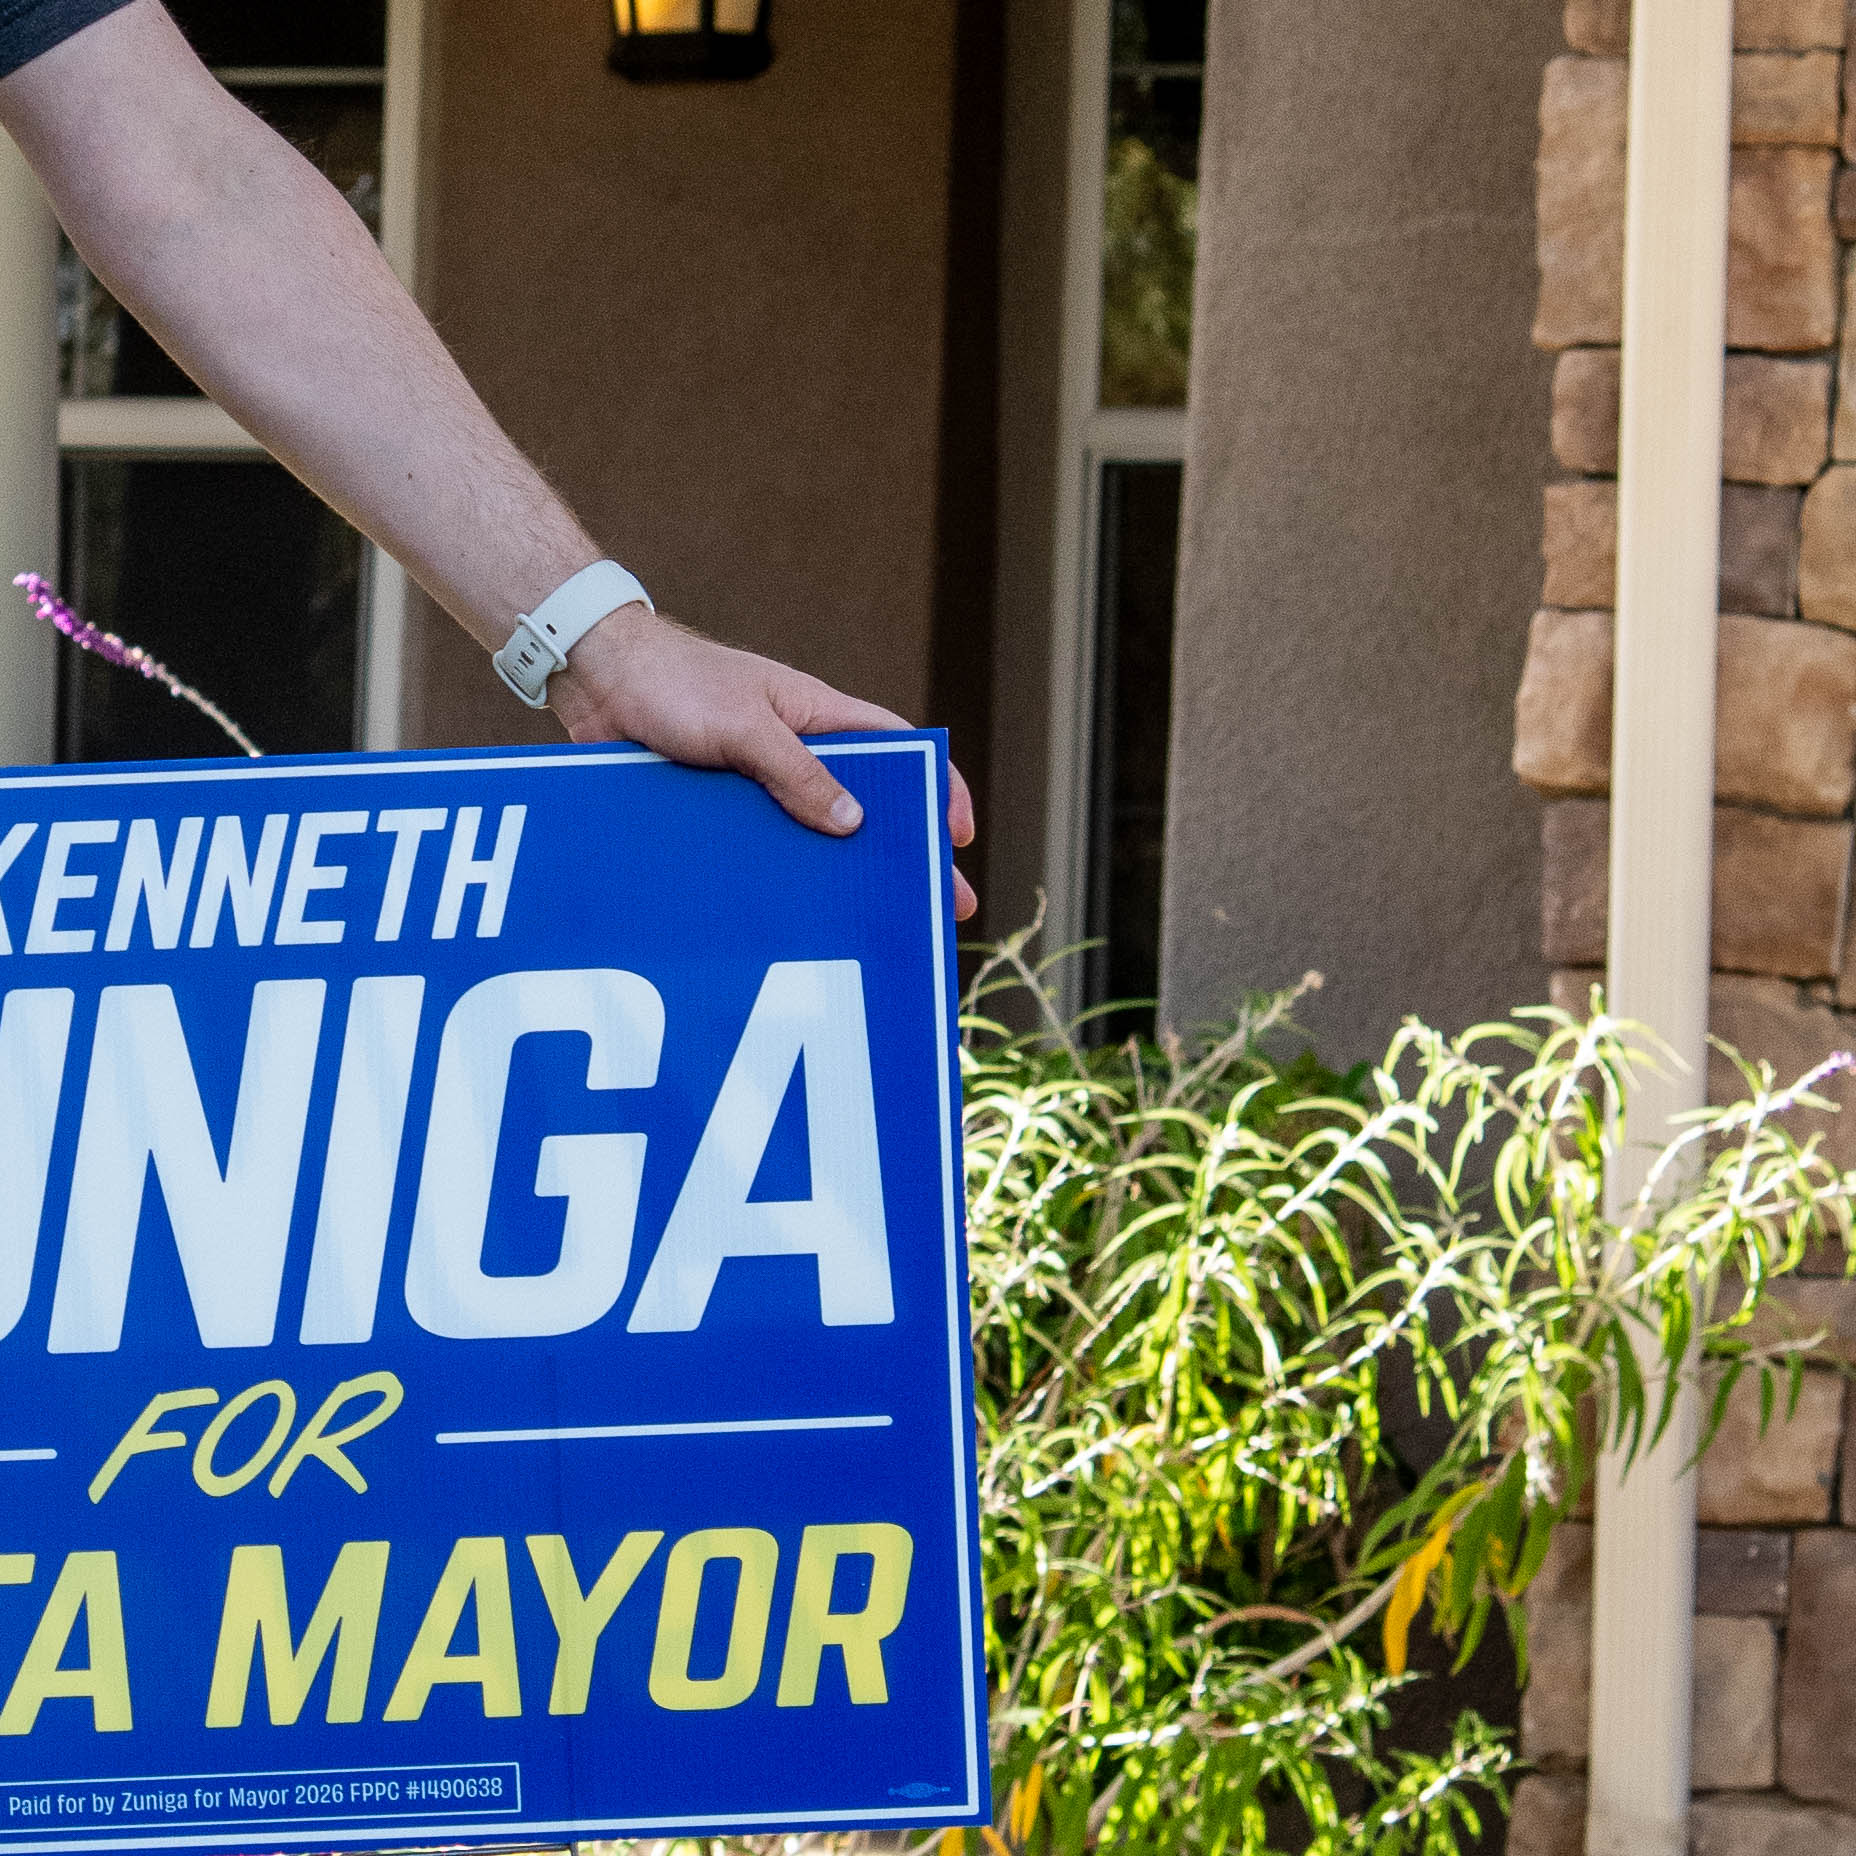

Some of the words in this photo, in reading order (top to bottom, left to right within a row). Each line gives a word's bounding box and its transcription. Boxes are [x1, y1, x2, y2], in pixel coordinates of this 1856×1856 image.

[88, 1371, 404, 1505] FOR
[205, 1522, 914, 1729] MAYOR
[9, 1795, 51, 1816] Paid
[57, 1794, 86, 1814] for
[92, 1793, 115, 1816] by
[121, 1791, 188, 1813] Zuniga
[194, 1789, 223, 1809] for
[229, 1787, 289, 1809] Mayor
[295, 1783, 344, 1805] 2026
[350, 1781, 400, 1802] FPPC
[406, 1777, 503, 1800] #1490638
